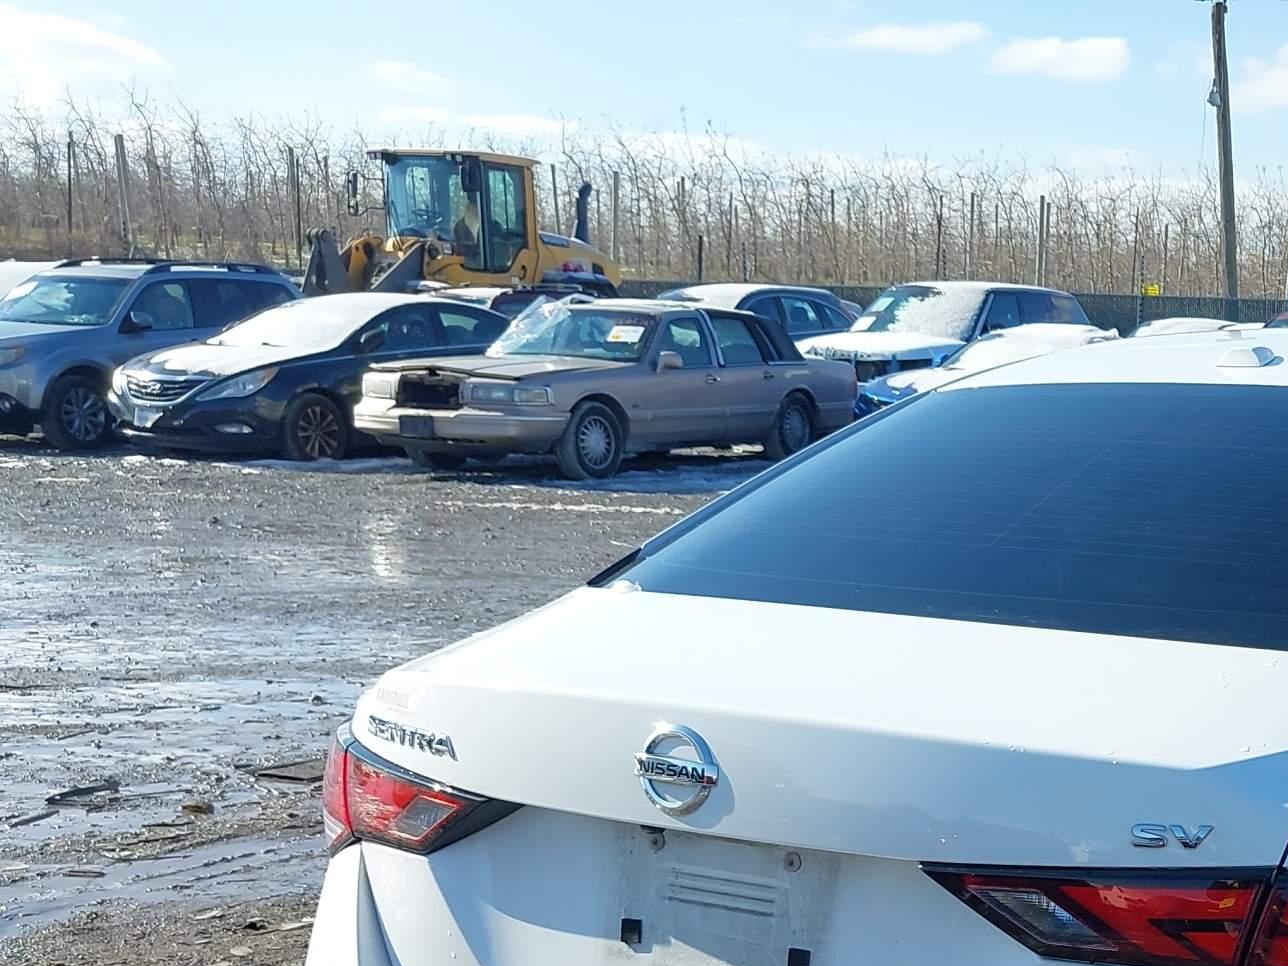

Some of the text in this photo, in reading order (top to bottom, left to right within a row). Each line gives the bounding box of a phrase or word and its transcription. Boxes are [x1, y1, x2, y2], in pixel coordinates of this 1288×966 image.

[368, 715, 458, 761] SENTRA
[639, 759, 705, 781] NISSAN
[1131, 823, 1214, 849] SV
